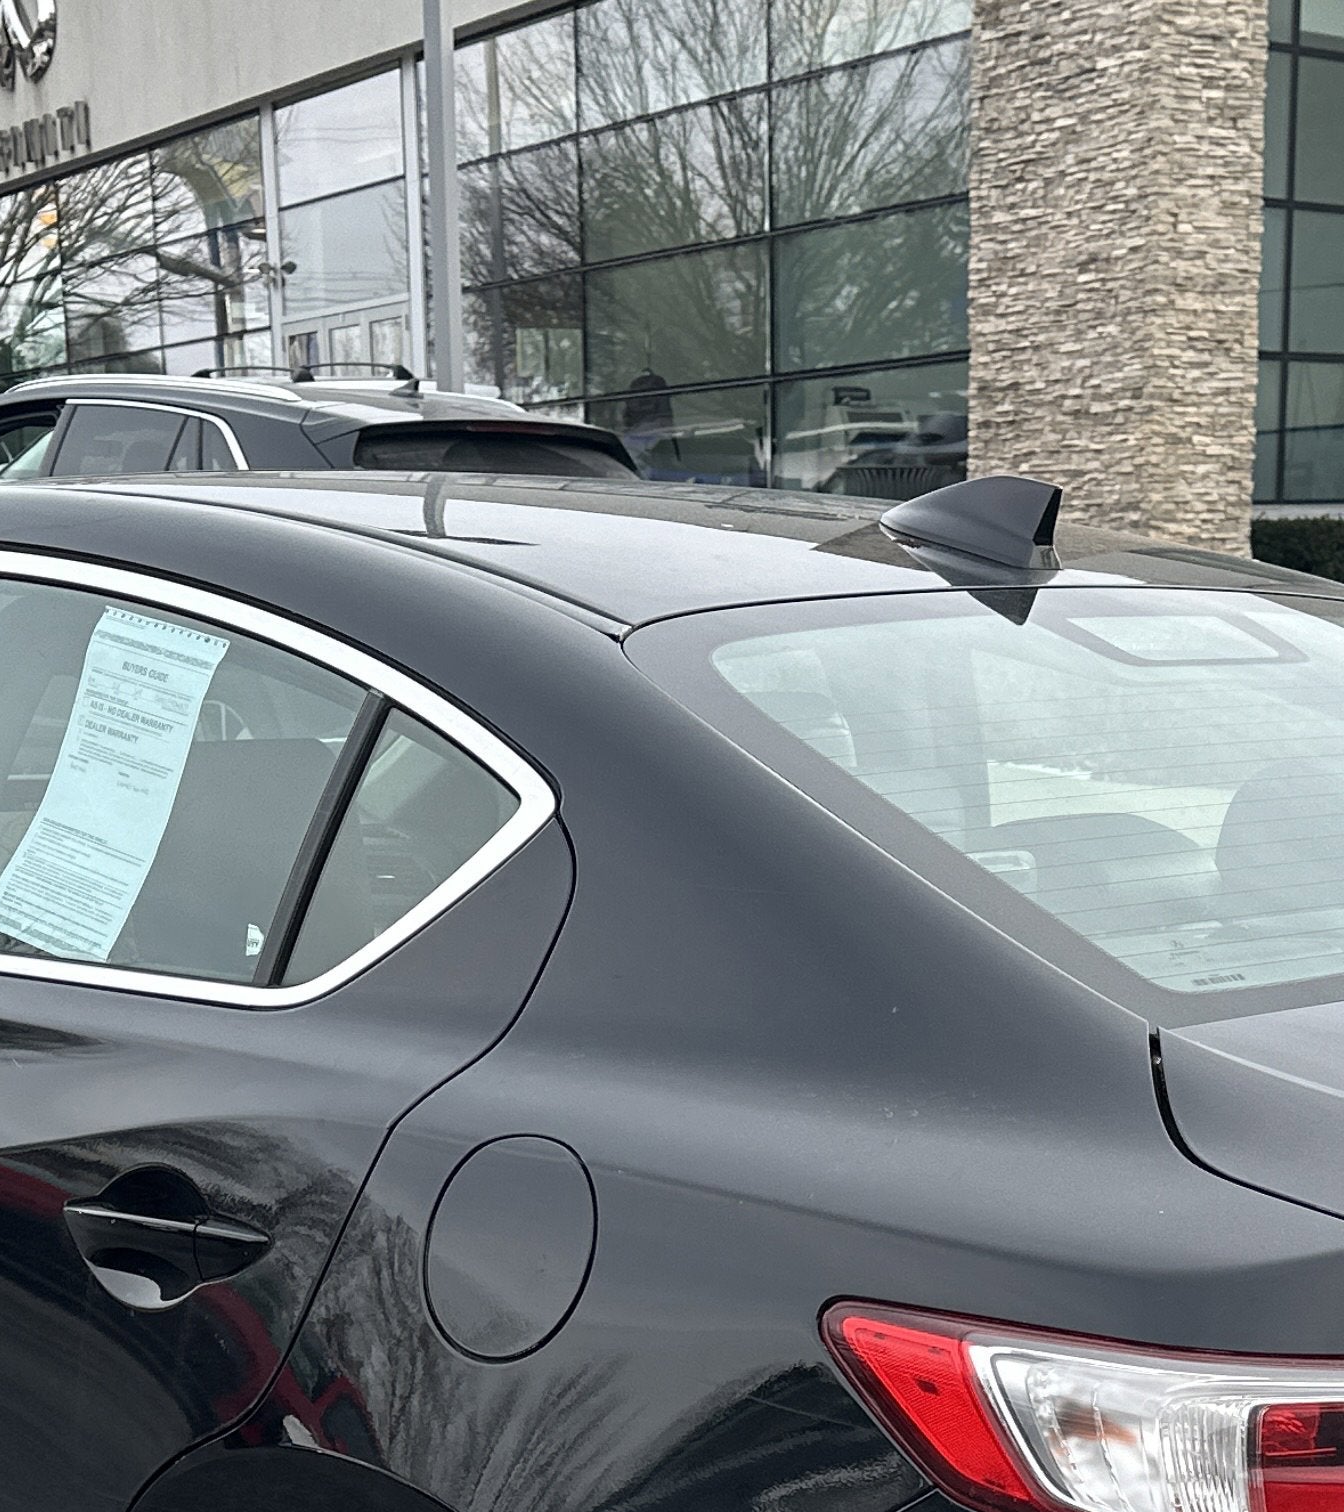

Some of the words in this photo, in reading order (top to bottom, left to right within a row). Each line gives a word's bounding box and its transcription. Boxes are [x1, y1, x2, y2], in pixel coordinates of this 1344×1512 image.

[85, 719, 107, 733] DEALER
[107, 725, 139, 743] WARRANTY
[117, 707, 140, 724] DEALER
[141, 716, 174, 733] WARRANTY
